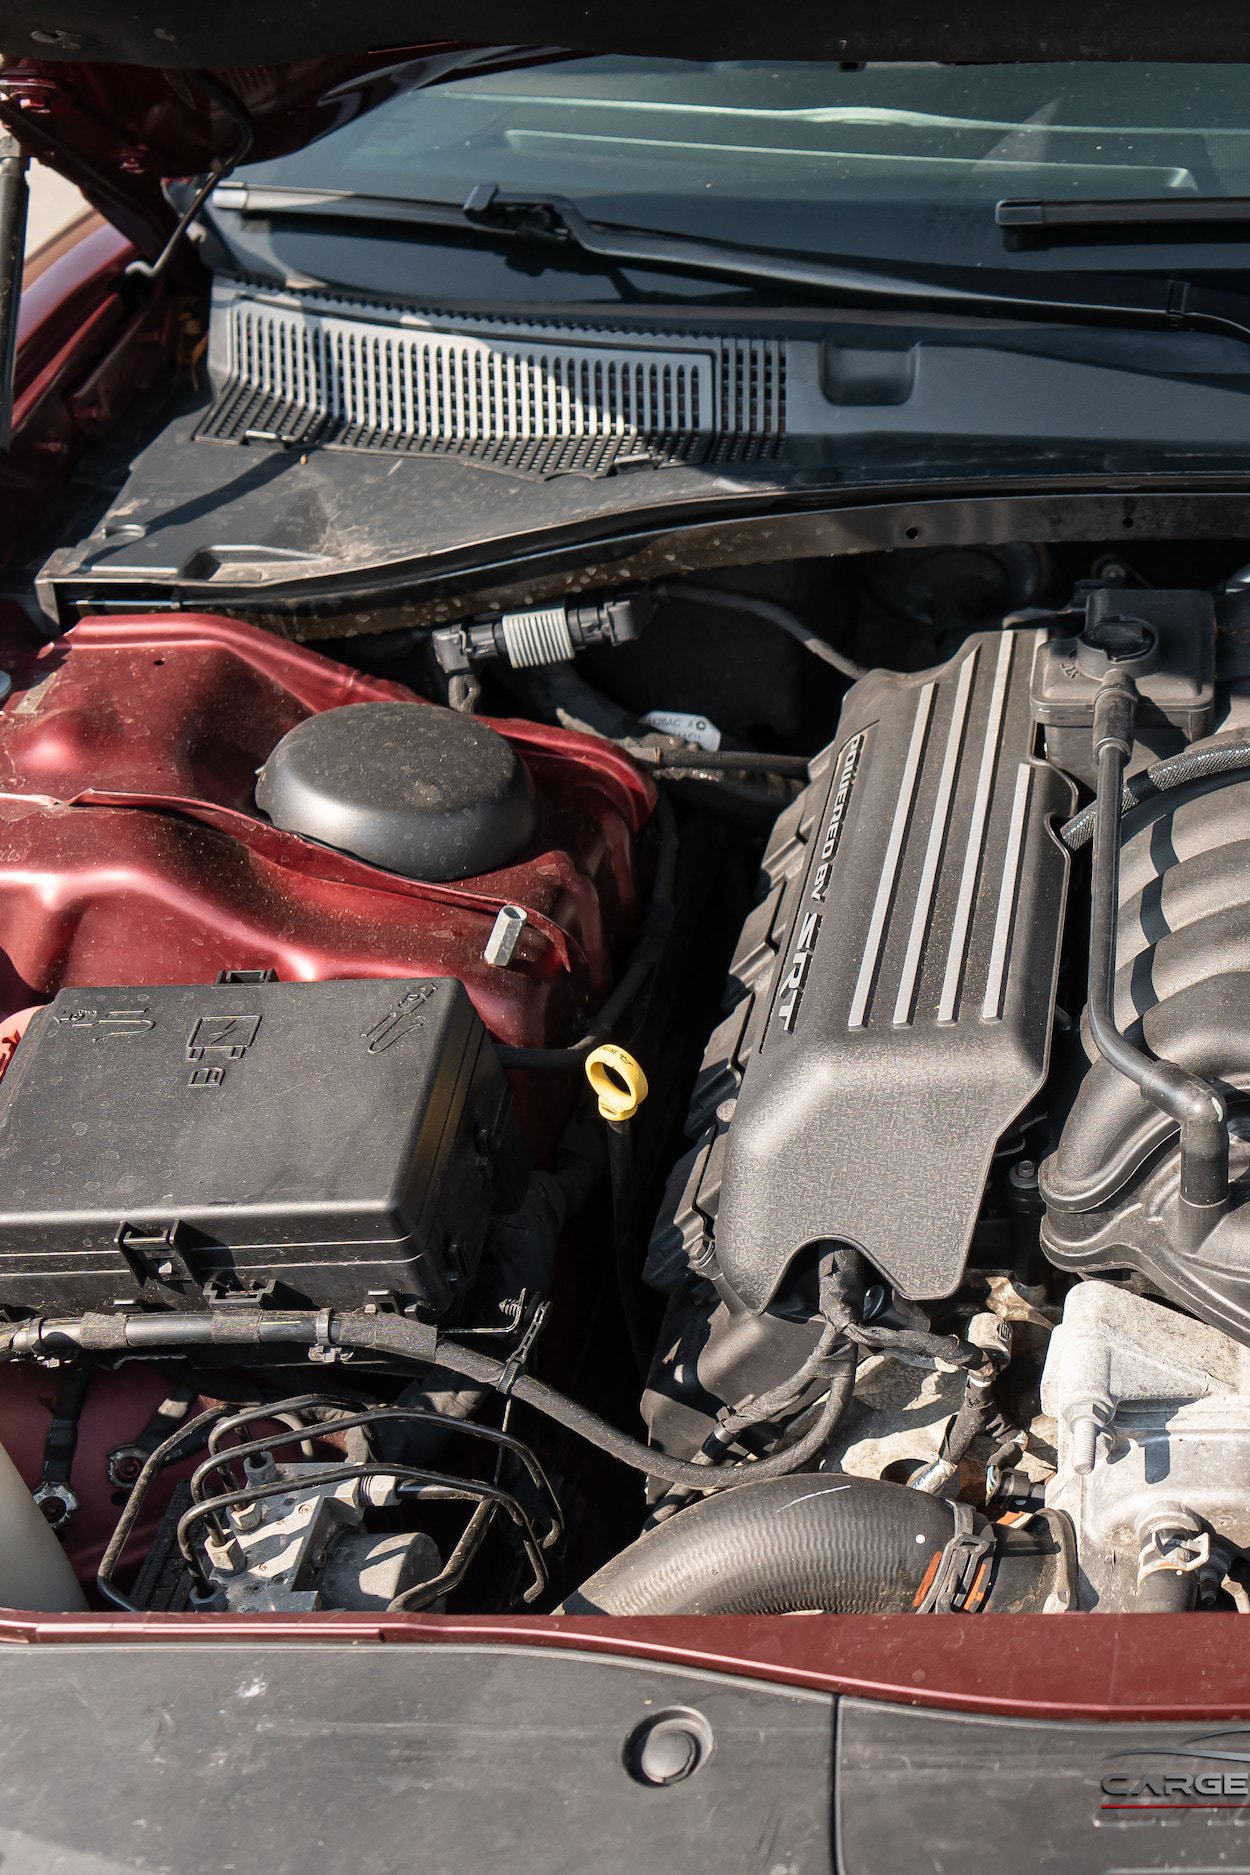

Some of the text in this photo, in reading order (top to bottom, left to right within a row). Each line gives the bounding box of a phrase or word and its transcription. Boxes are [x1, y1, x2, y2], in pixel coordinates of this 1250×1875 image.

[779, 734, 864, 1035] POWERED BY SRT
